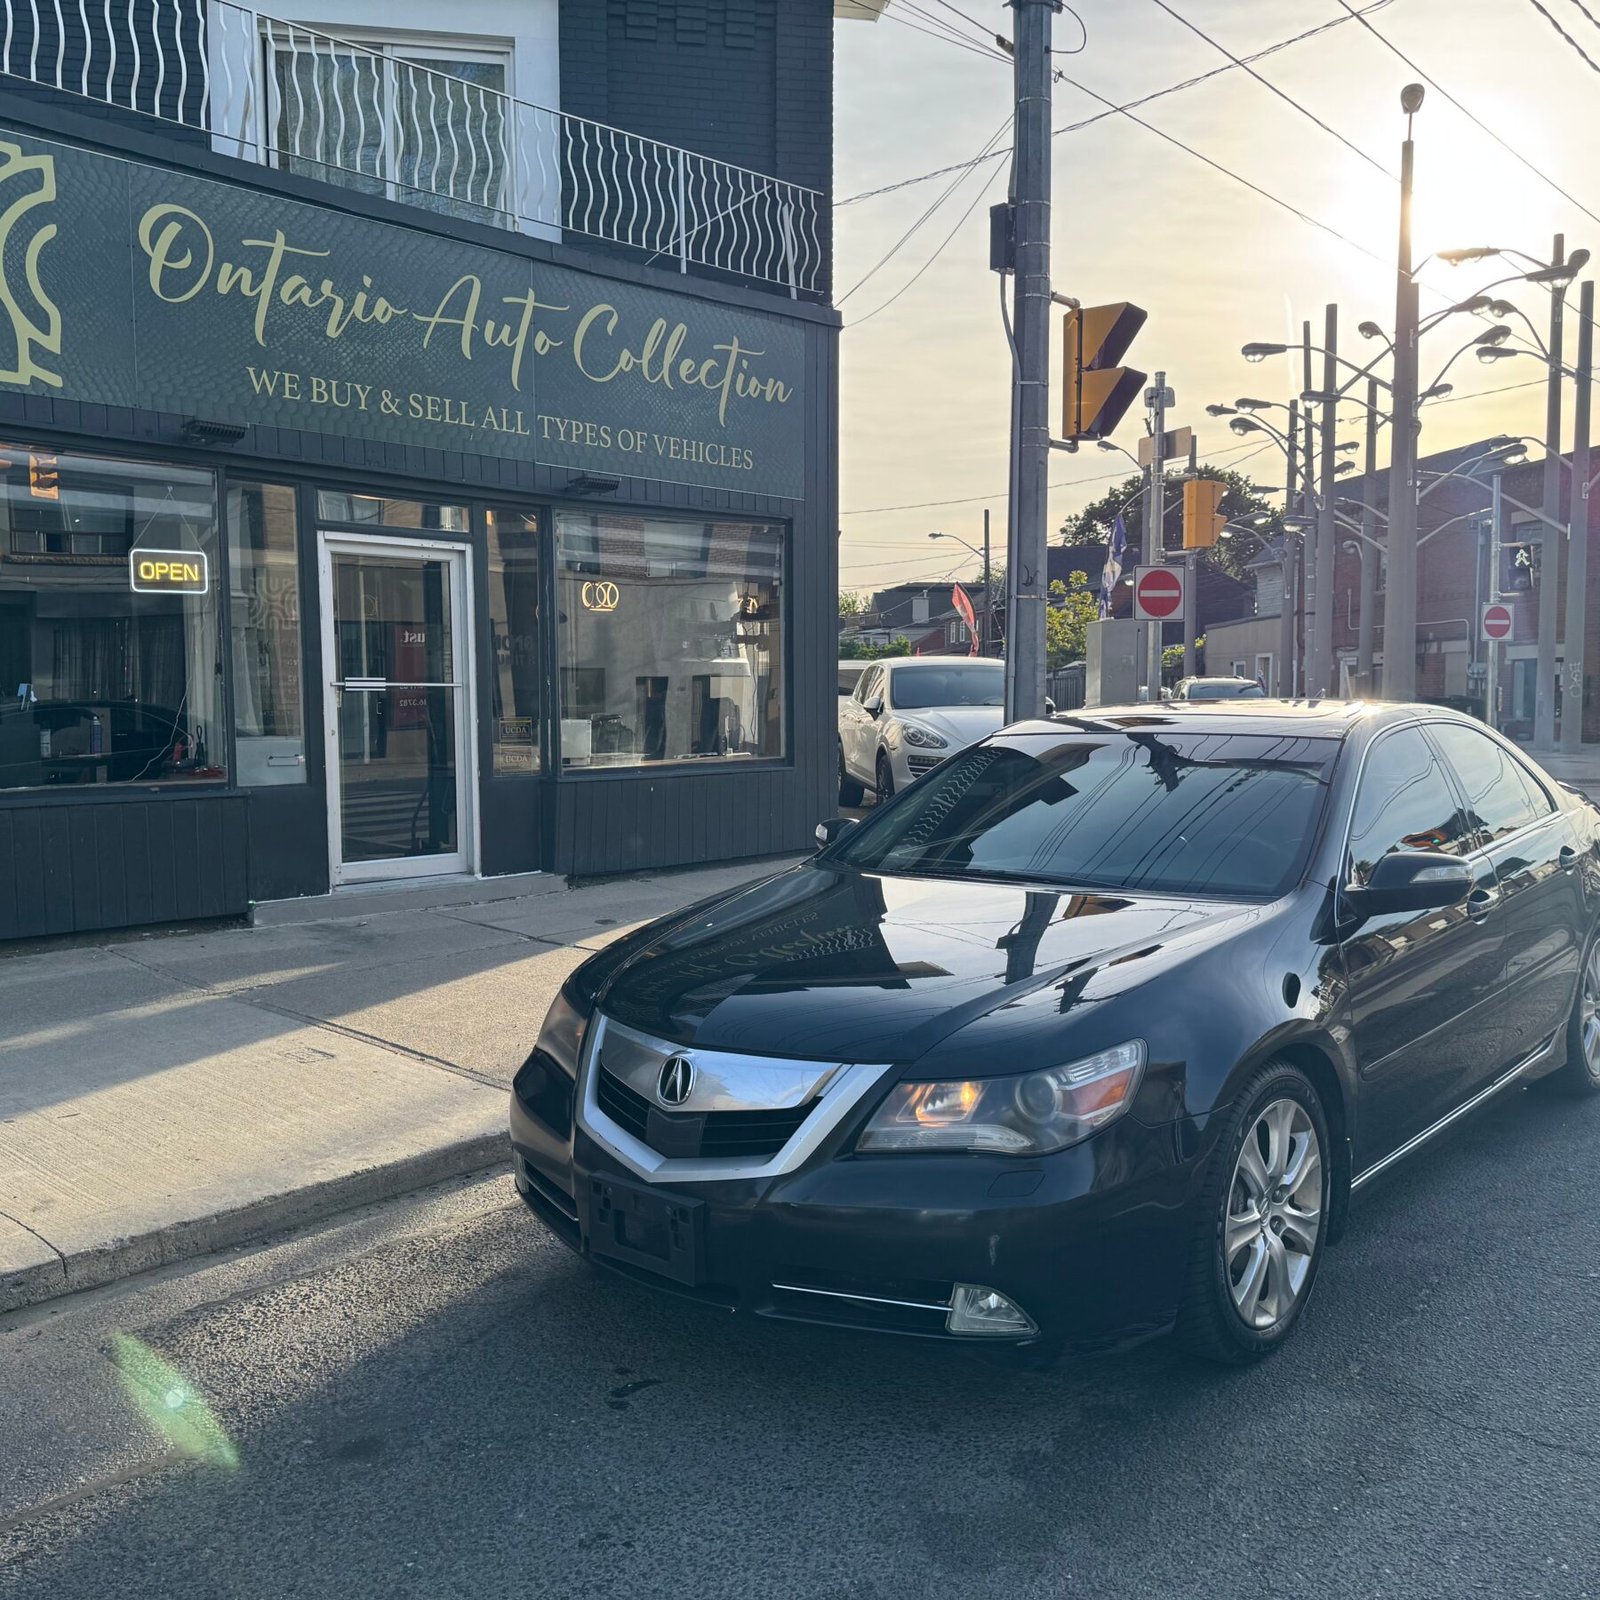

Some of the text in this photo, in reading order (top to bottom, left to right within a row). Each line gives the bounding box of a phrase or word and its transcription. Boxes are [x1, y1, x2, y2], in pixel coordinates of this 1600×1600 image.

[138, 203, 793, 426] Ontario Auto Collection
[246, 367, 754, 470] WE BUY & SELL ALL TYPES OF VEHICLES
[140, 562, 199, 581] OPEN
[505, 726, 527, 734] UCDA
